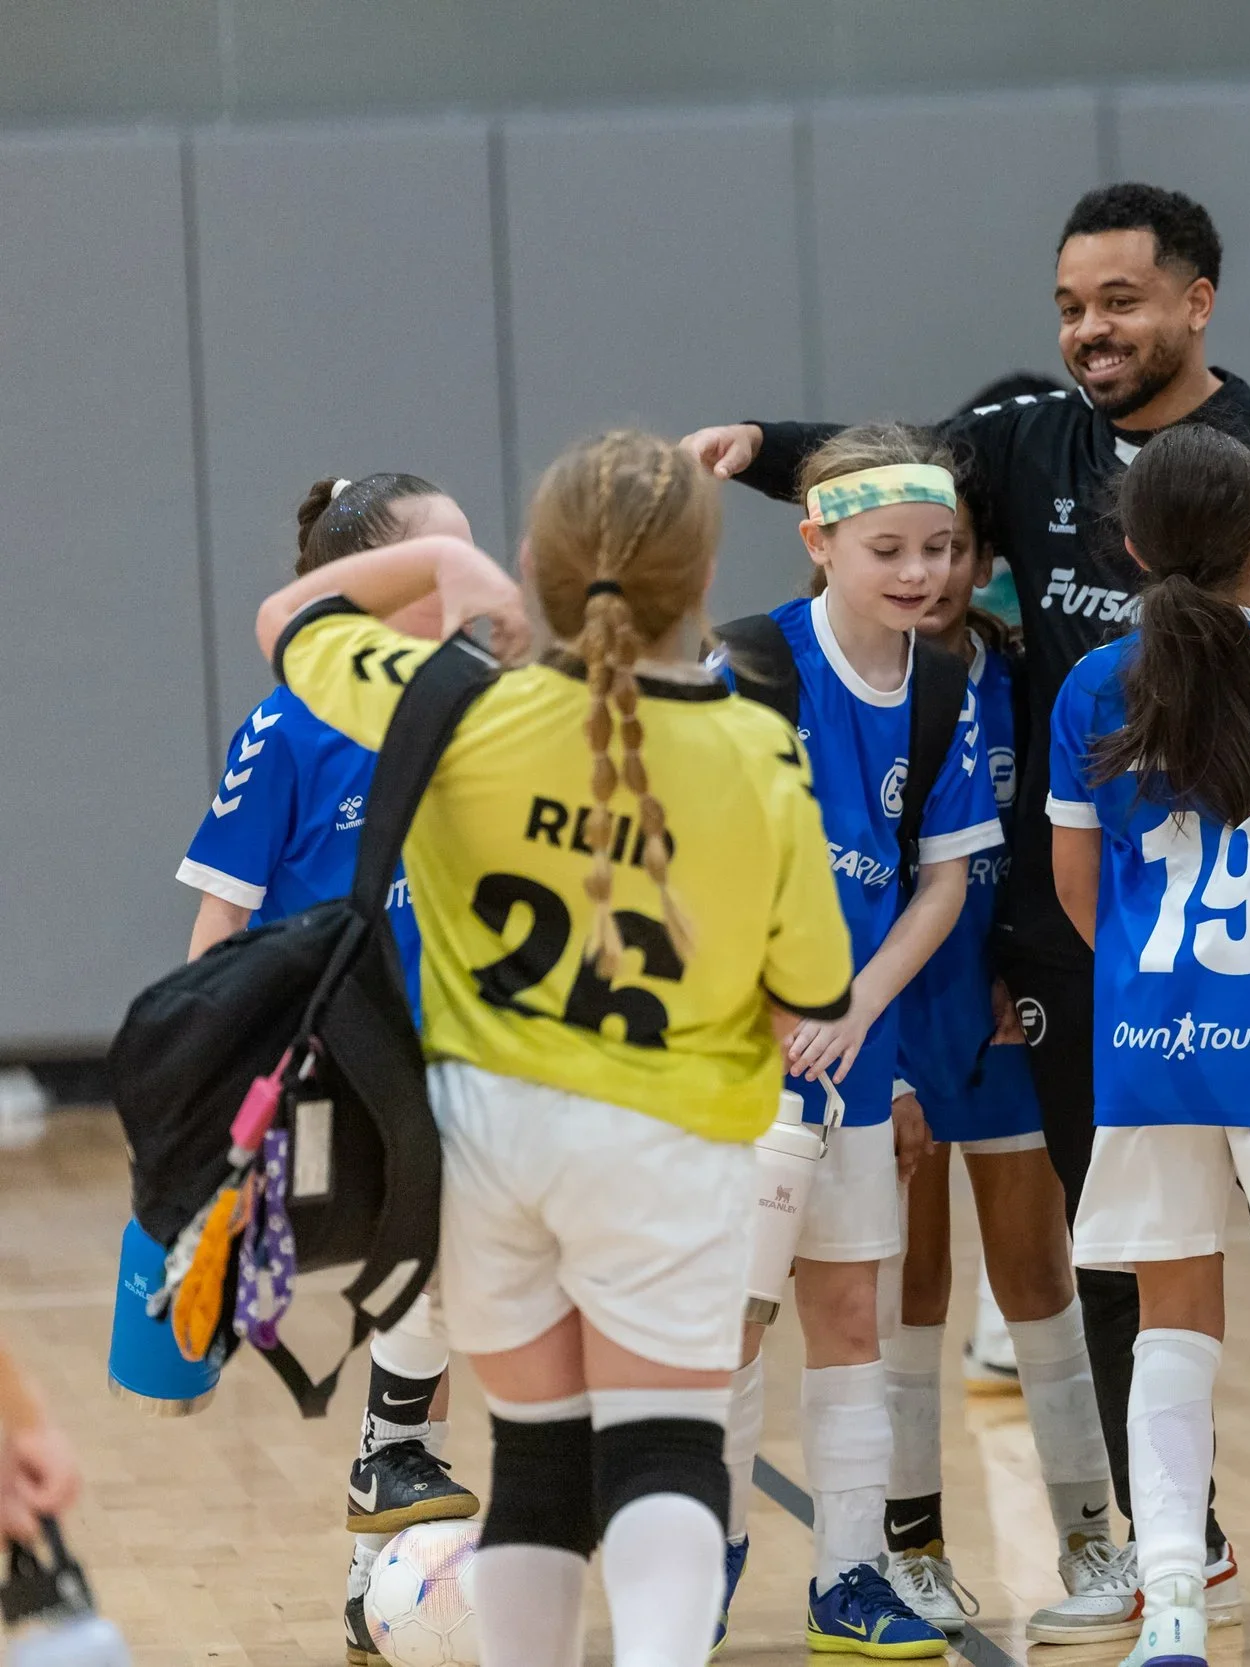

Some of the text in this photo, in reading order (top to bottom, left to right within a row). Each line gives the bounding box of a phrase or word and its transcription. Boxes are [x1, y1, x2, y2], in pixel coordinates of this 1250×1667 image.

[1048, 520, 1077, 534] hummel
[1040, 567, 1144, 625] FUTSA
[335, 817, 367, 832] humm
[470, 872, 686, 1051] 26
[1113, 1021, 1171, 1049] Own
[758, 1198, 798, 1214] STANLEY
[124, 1280, 155, 1301] STANLE
